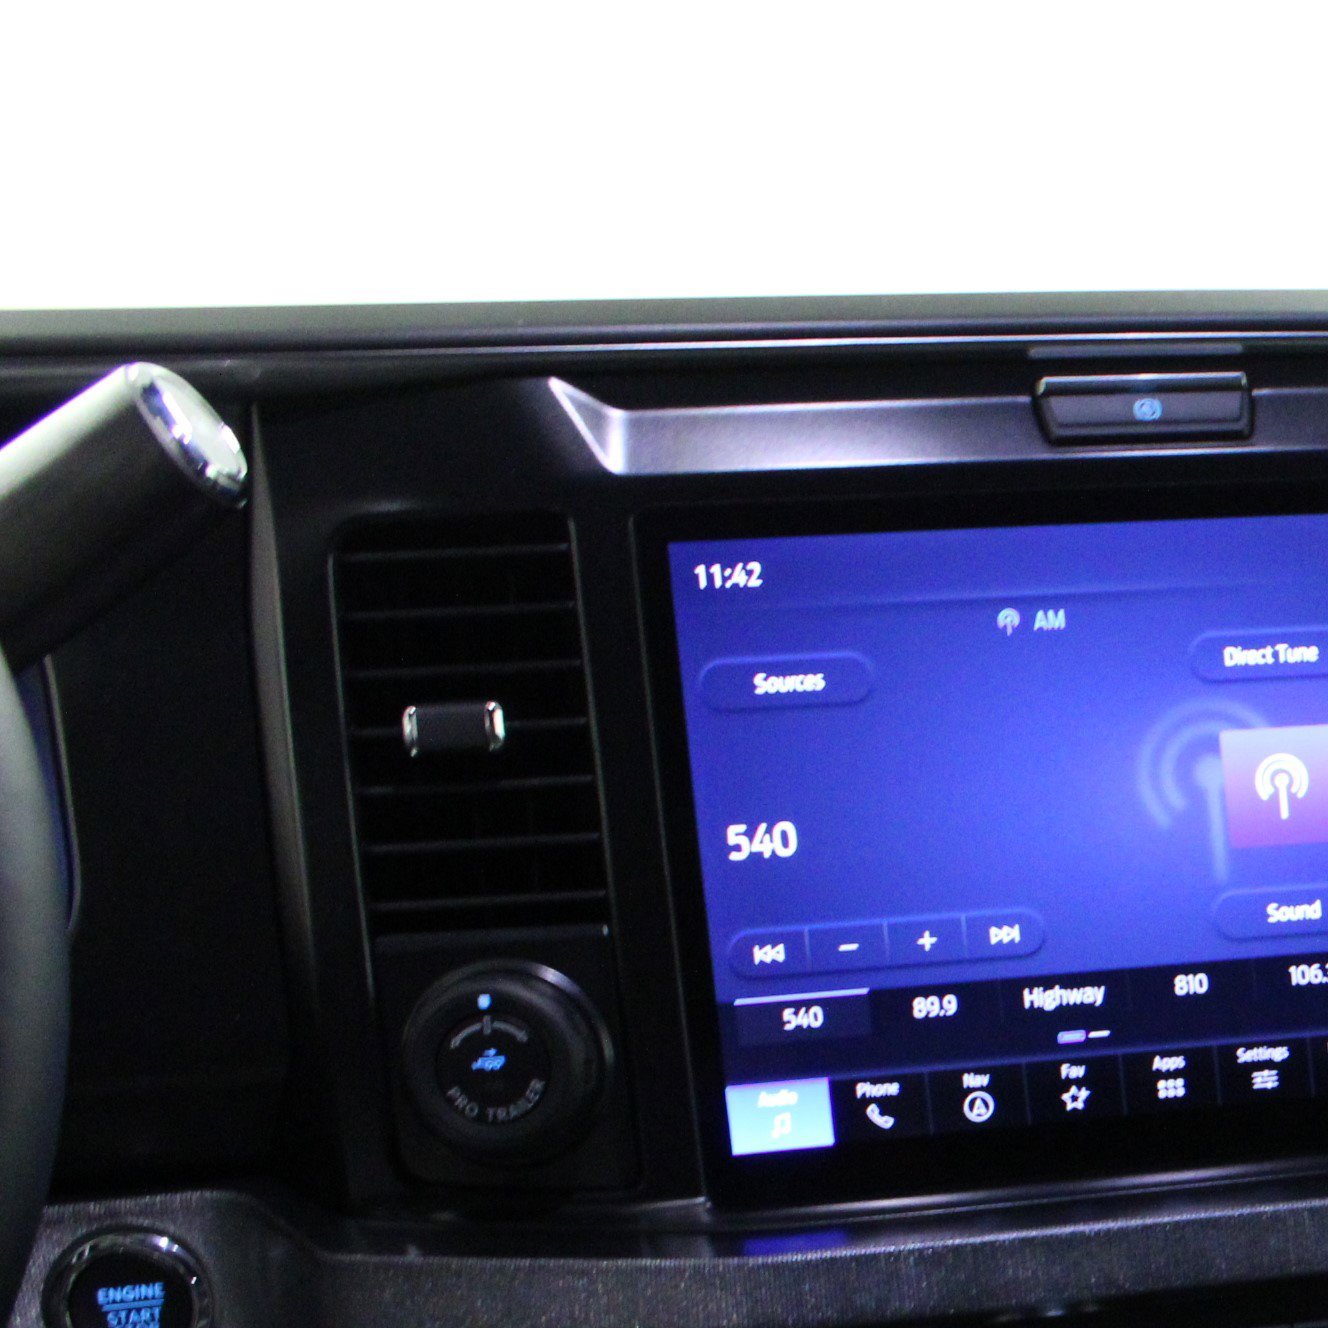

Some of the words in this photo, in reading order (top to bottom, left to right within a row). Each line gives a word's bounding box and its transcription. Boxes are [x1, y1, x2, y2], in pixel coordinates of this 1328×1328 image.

[694, 561, 763, 590] 11:42
[1034, 609, 1066, 630] AM
[1223, 645, 1275, 667] Direct
[1274, 643, 1319, 664] Tune
[753, 672, 826, 695] Sources
[726, 820, 799, 861] 540
[1266, 899, 1323, 924] Sound
[1173, 972, 1210, 997] 810
[911, 993, 959, 1020] 89.9
[1022, 984, 1107, 1011] Highway
[782, 1004, 824, 1031] 540
[1151, 1054, 1187, 1073] Apps
[1235, 1044, 1290, 1065] Settings
[961, 1072, 991, 1089] Nav
[1059, 1062, 1087, 1081] Fav
[855, 1082, 901, 1099] Phone
[97, 1282, 165, 1305] ENGINE
[106, 1306, 161, 1328] START
